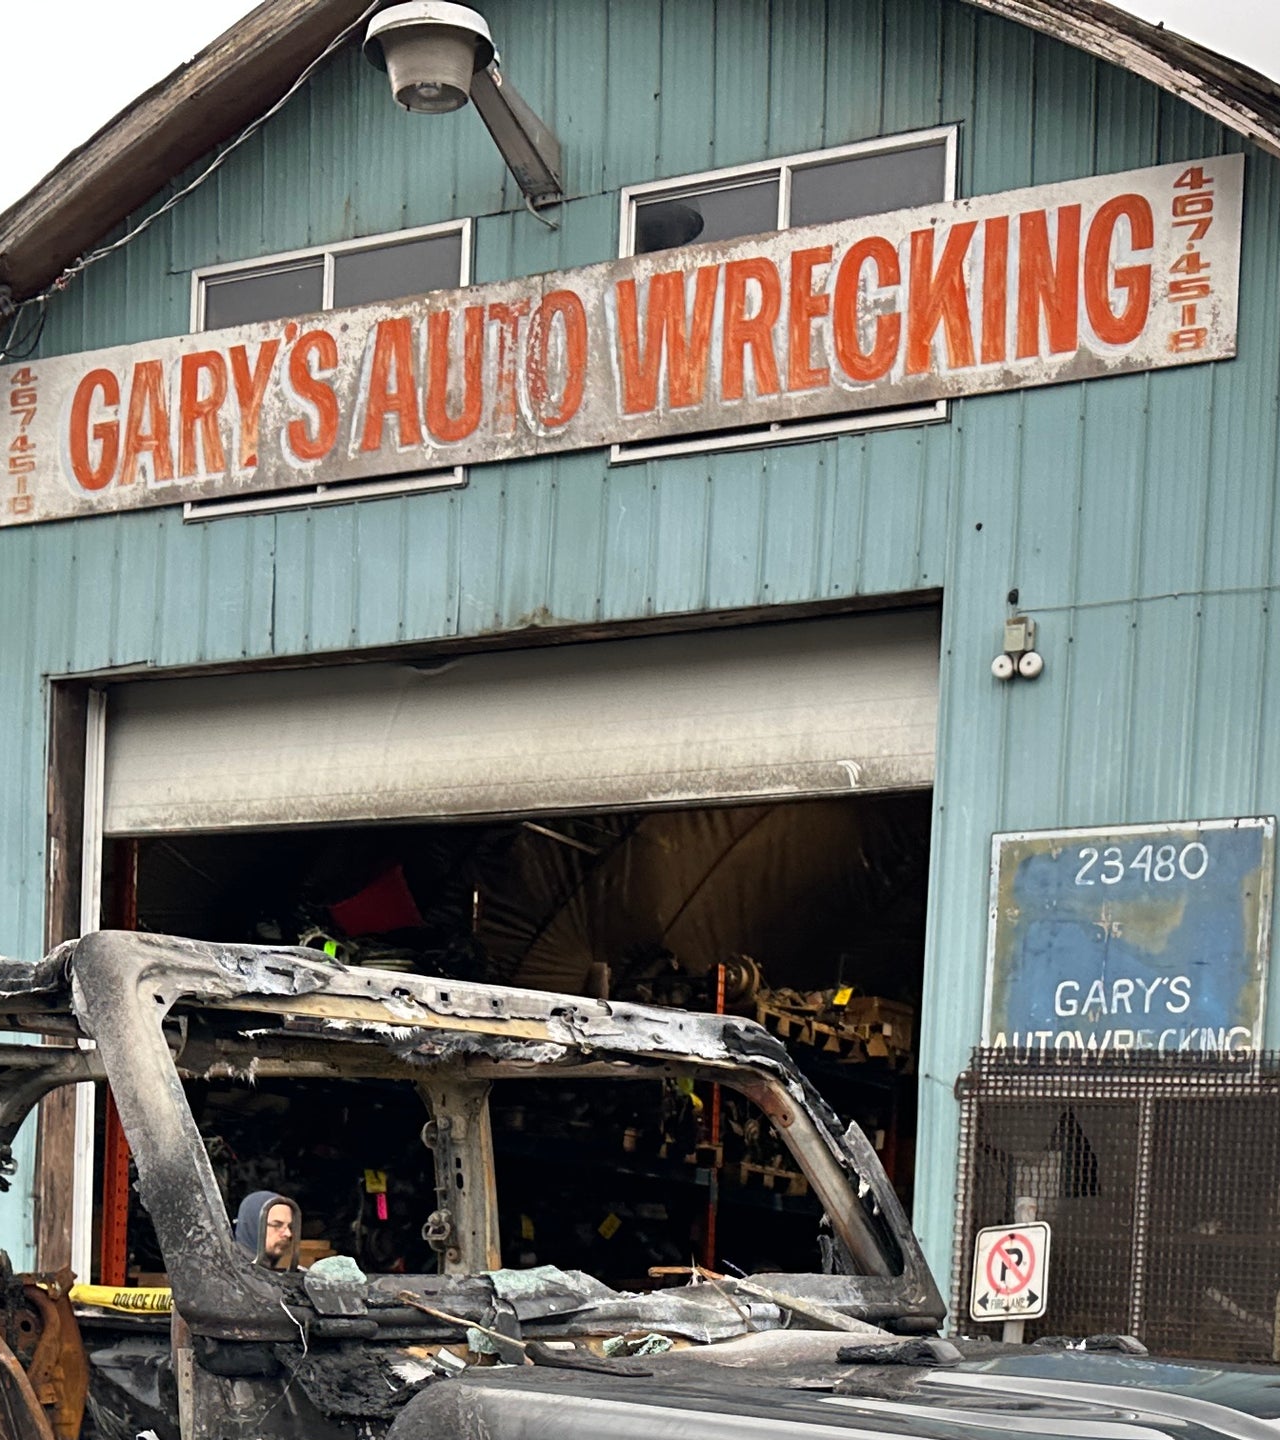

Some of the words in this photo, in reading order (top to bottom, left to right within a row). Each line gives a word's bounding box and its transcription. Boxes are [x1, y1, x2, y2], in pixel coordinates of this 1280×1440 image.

[68, 322, 338, 491] GARY'S
[361, 289, 588, 452] AUTO
[616, 193, 1155, 415] WRECKING
[1076, 843, 1209, 885] 23480
[1055, 977, 1191, 1017] GARY'S
[113, 1293, 149, 1310] POLICE
